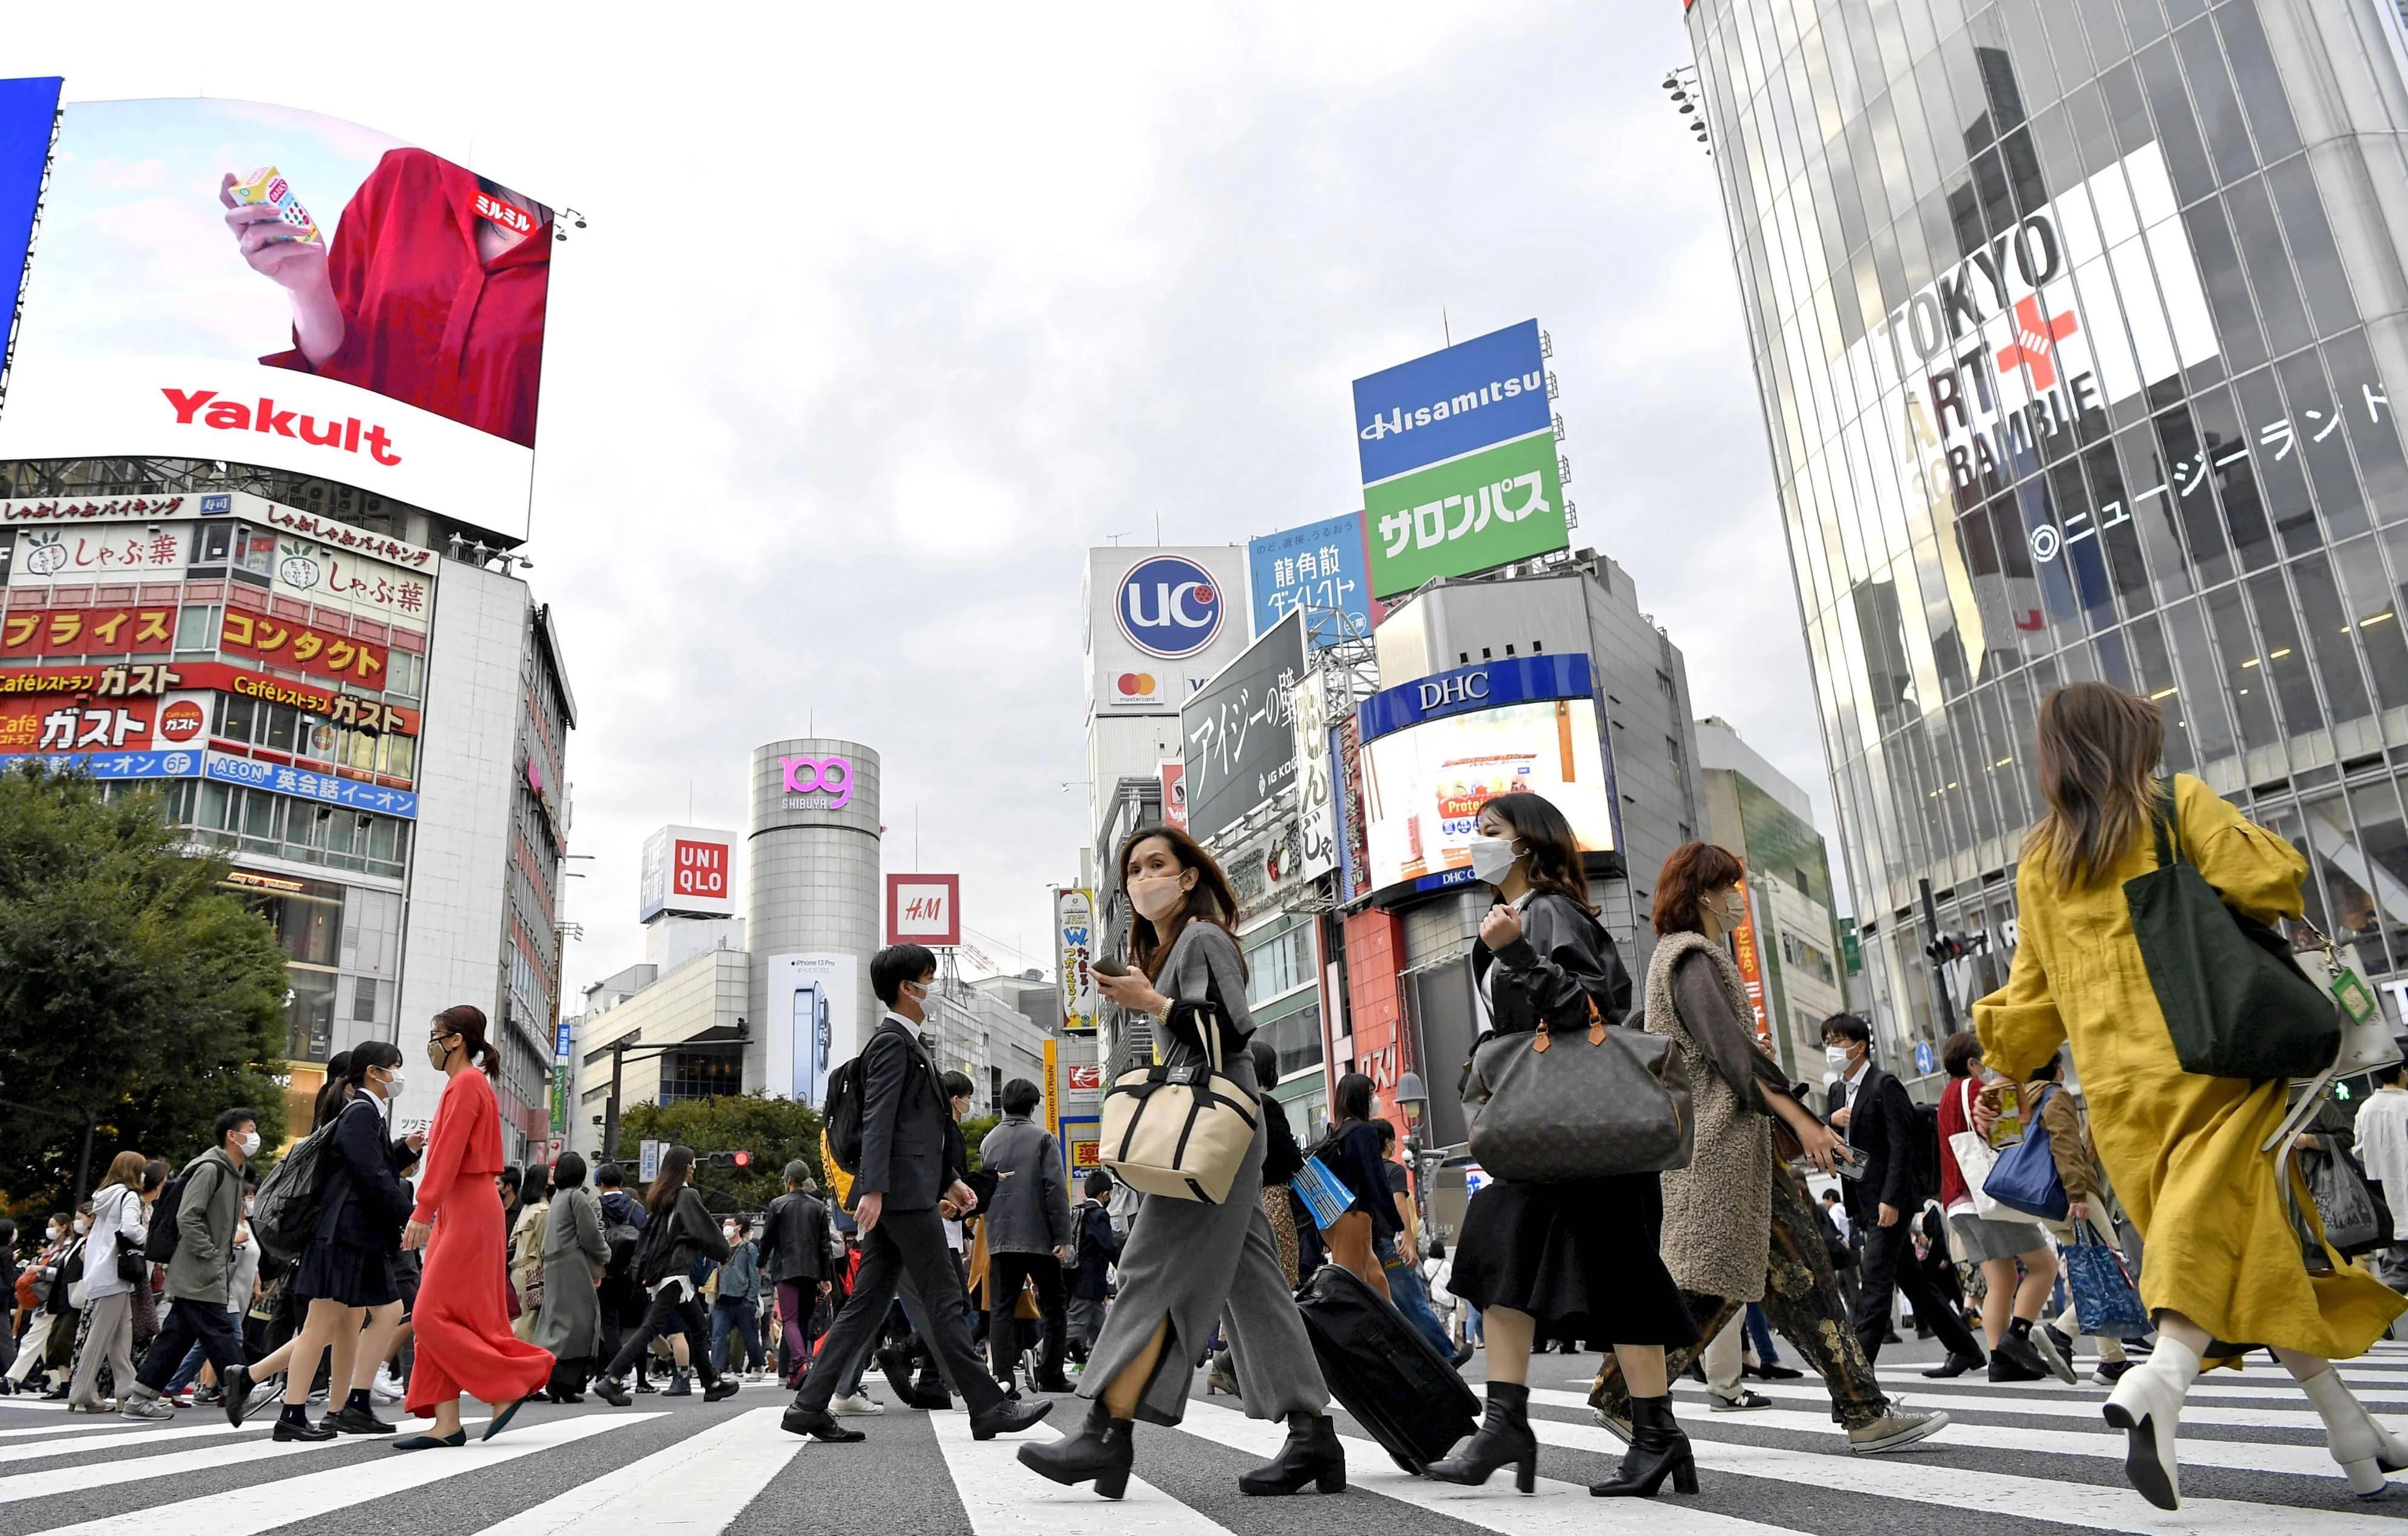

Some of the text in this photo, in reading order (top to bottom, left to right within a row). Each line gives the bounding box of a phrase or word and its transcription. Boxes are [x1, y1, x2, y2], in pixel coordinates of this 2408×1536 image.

[475, 194, 531, 232] ミルミル
[1876, 214, 2062, 381] TOKYO
[1361, 370, 1541, 441] Hisamitsu
[1904, 343, 1994, 464] ART
[161, 388, 402, 466] Yakult
[4, 496, 184, 520] しゃぶしゃぶバイキング
[203, 498, 228, 511] 寿司
[1378, 469, 1550, 558] サロンパス
[75, 533, 178, 566] しゃぶ葉
[268, 504, 430, 567] しゃぶしゃぶバイキング
[1274, 543, 1341, 589] 龍角散
[329, 561, 424, 613] しゃぶ葉
[1267, 577, 1355, 620] ダイレクト
[5, 611, 173, 648] プライス
[223, 612, 382, 678] コンタクト
[97, 664, 181, 696] ガスト
[1418, 671, 1490, 711] DHC
[39, 706, 146, 750] ガスト
[164, 719, 200, 731] ガスト
[331, 695, 405, 736] ガスト
[166, 755, 189, 771] 6F
[215, 758, 265, 782] AEON
[1267, 770, 1277, 786] IG
[778, 757, 854, 810] 109
[782, 797, 827, 809] SHIBUYA
[1448, 798, 1484, 814] Protei
[681, 847, 719, 868] UNI
[641, 870, 663, 910] PRIME
[680, 870, 722, 892] QLO
[1442, 870, 1466, 885] DHC
[905, 897, 940, 921] H&M
[402, 1118, 433, 1130] ツツミ
[1078, 1143, 1100, 1165] 薬
